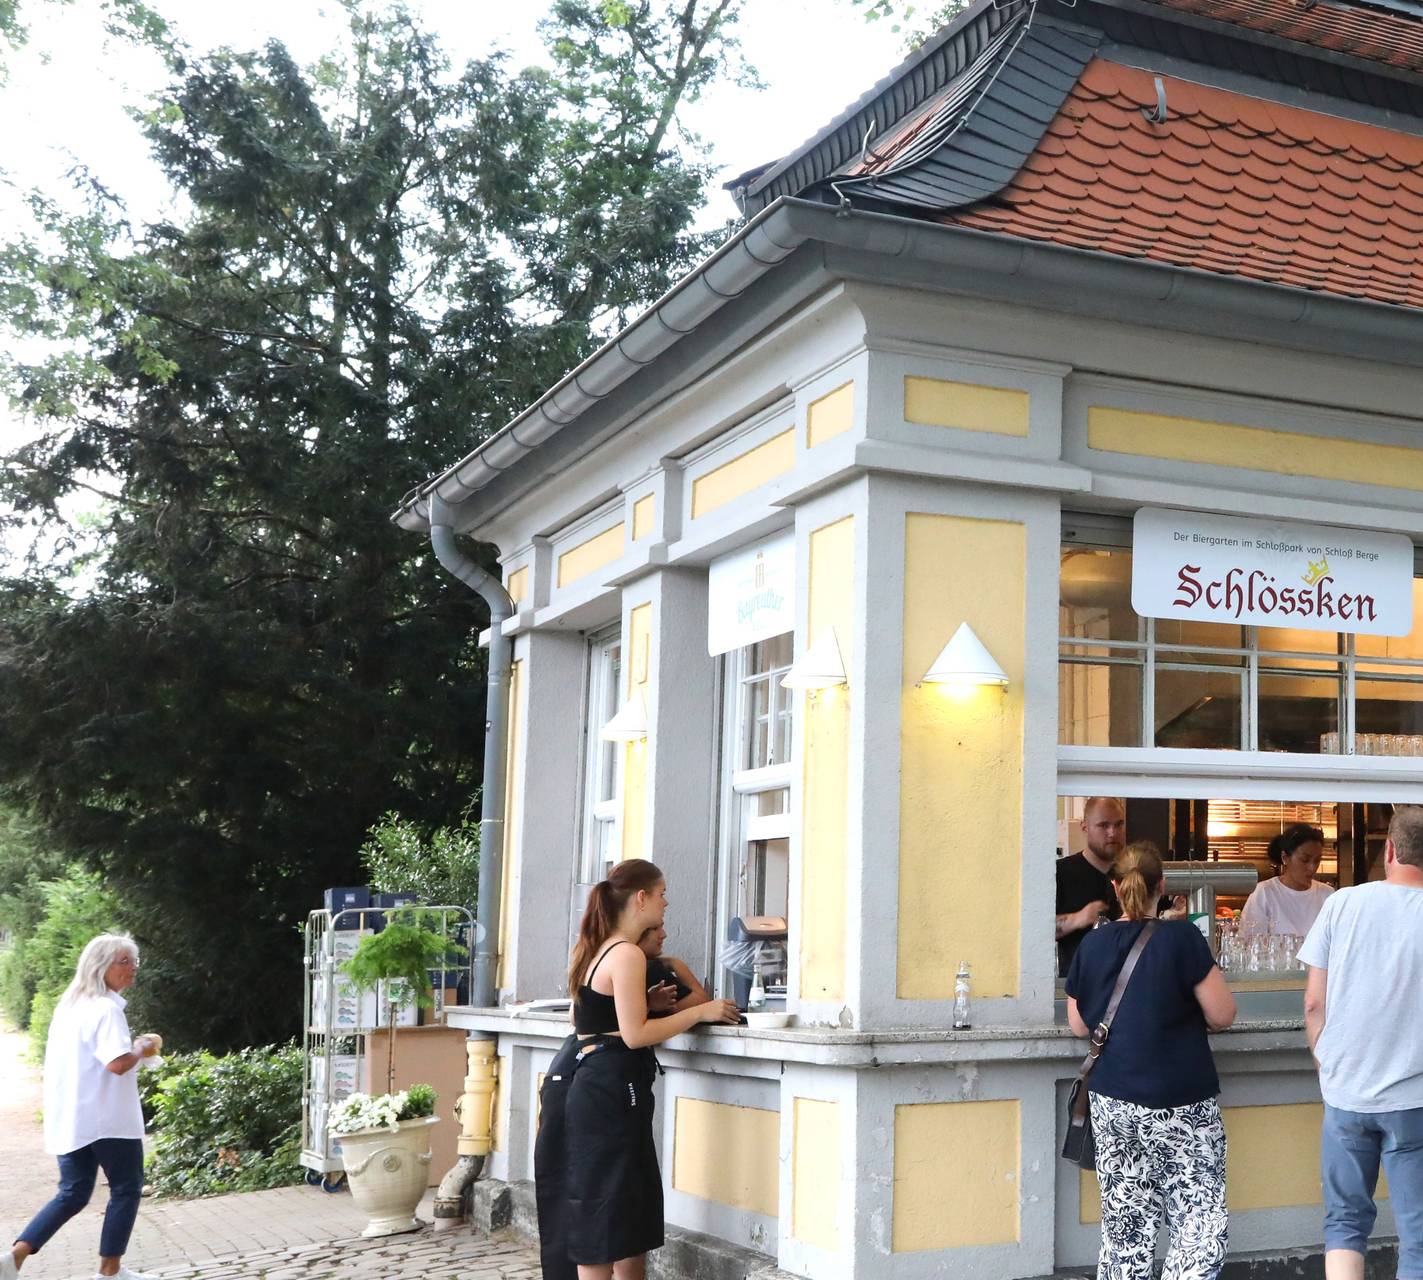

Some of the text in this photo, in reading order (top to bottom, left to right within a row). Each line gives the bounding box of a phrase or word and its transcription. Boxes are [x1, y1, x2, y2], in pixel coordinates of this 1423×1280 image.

[1173, 531, 1379, 561] Der Biergarten im Schloßpark von Schloß Berge
[1172, 563, 1377, 621] Schlössken
